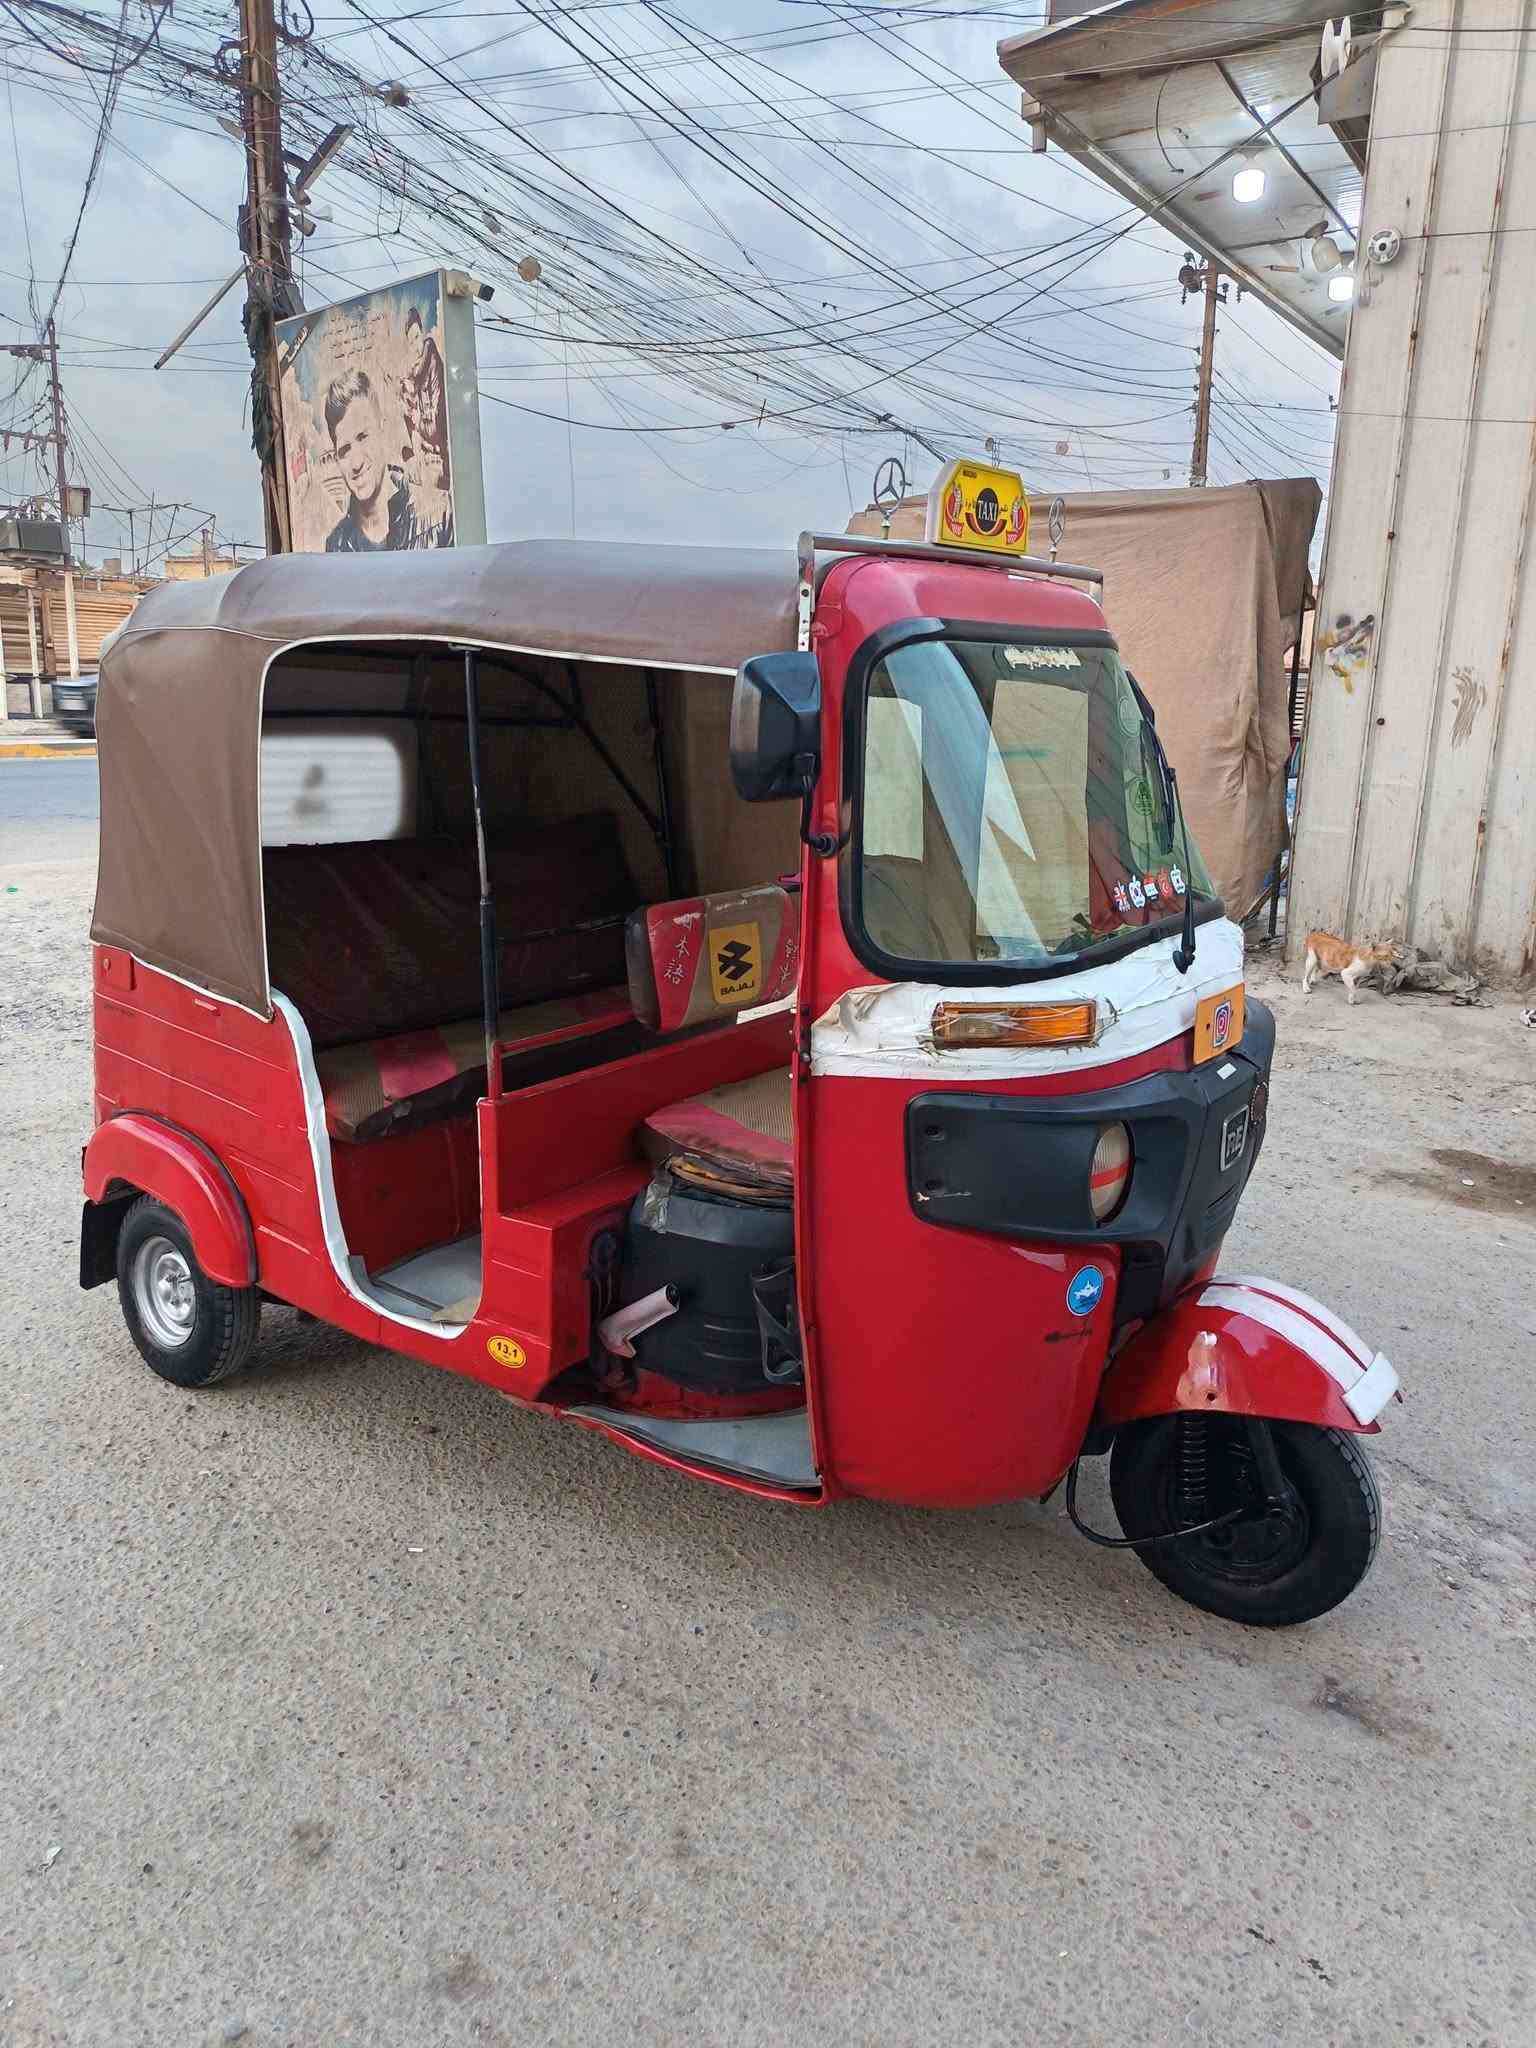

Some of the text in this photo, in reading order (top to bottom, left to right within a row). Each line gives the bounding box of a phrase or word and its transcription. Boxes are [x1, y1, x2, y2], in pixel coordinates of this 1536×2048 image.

[978, 500, 998, 521] TAXI
[720, 980, 755, 996] BAJAJ
[1226, 1124, 1244, 1158] RE
[497, 1342, 518, 1358] 13.1
